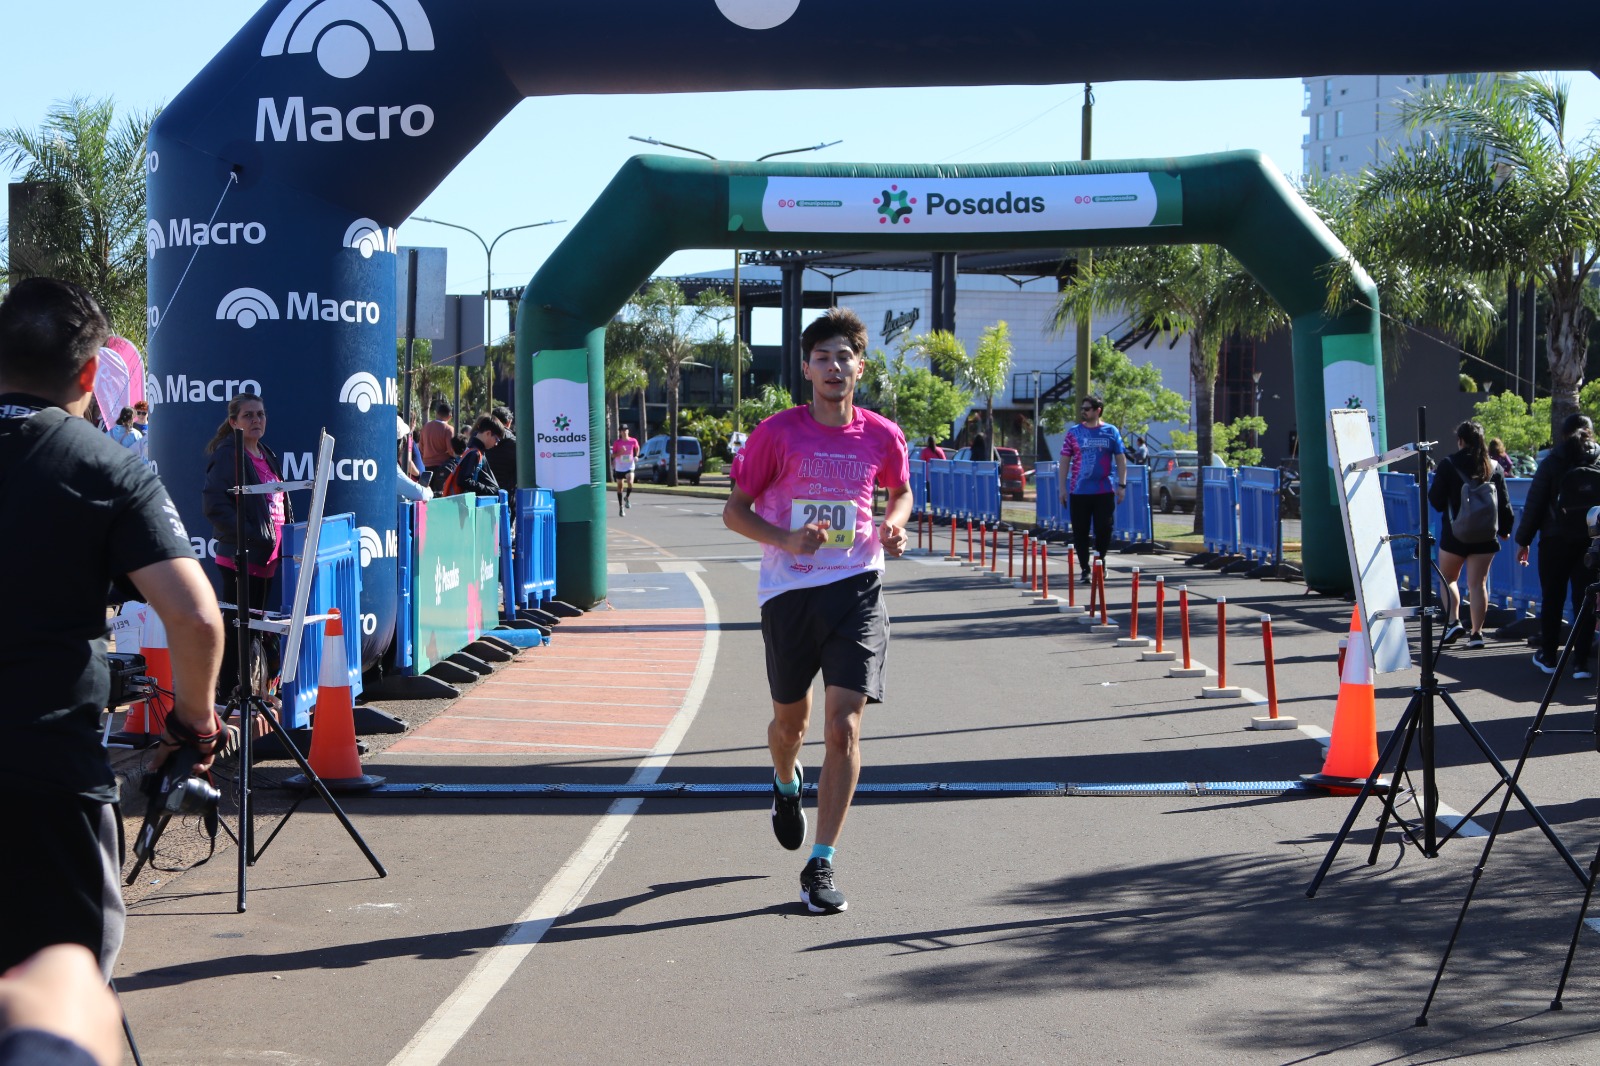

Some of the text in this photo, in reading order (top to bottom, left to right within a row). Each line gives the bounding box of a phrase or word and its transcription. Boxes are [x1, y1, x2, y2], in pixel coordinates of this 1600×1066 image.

[256, 97, 434, 141] Macro
[927, 191, 1045, 214] Posadas
[169, 218, 266, 247] Macro
[287, 292, 380, 324] Macro
[537, 432, 587, 443] Posadas
[803, 504, 846, 531] 260
